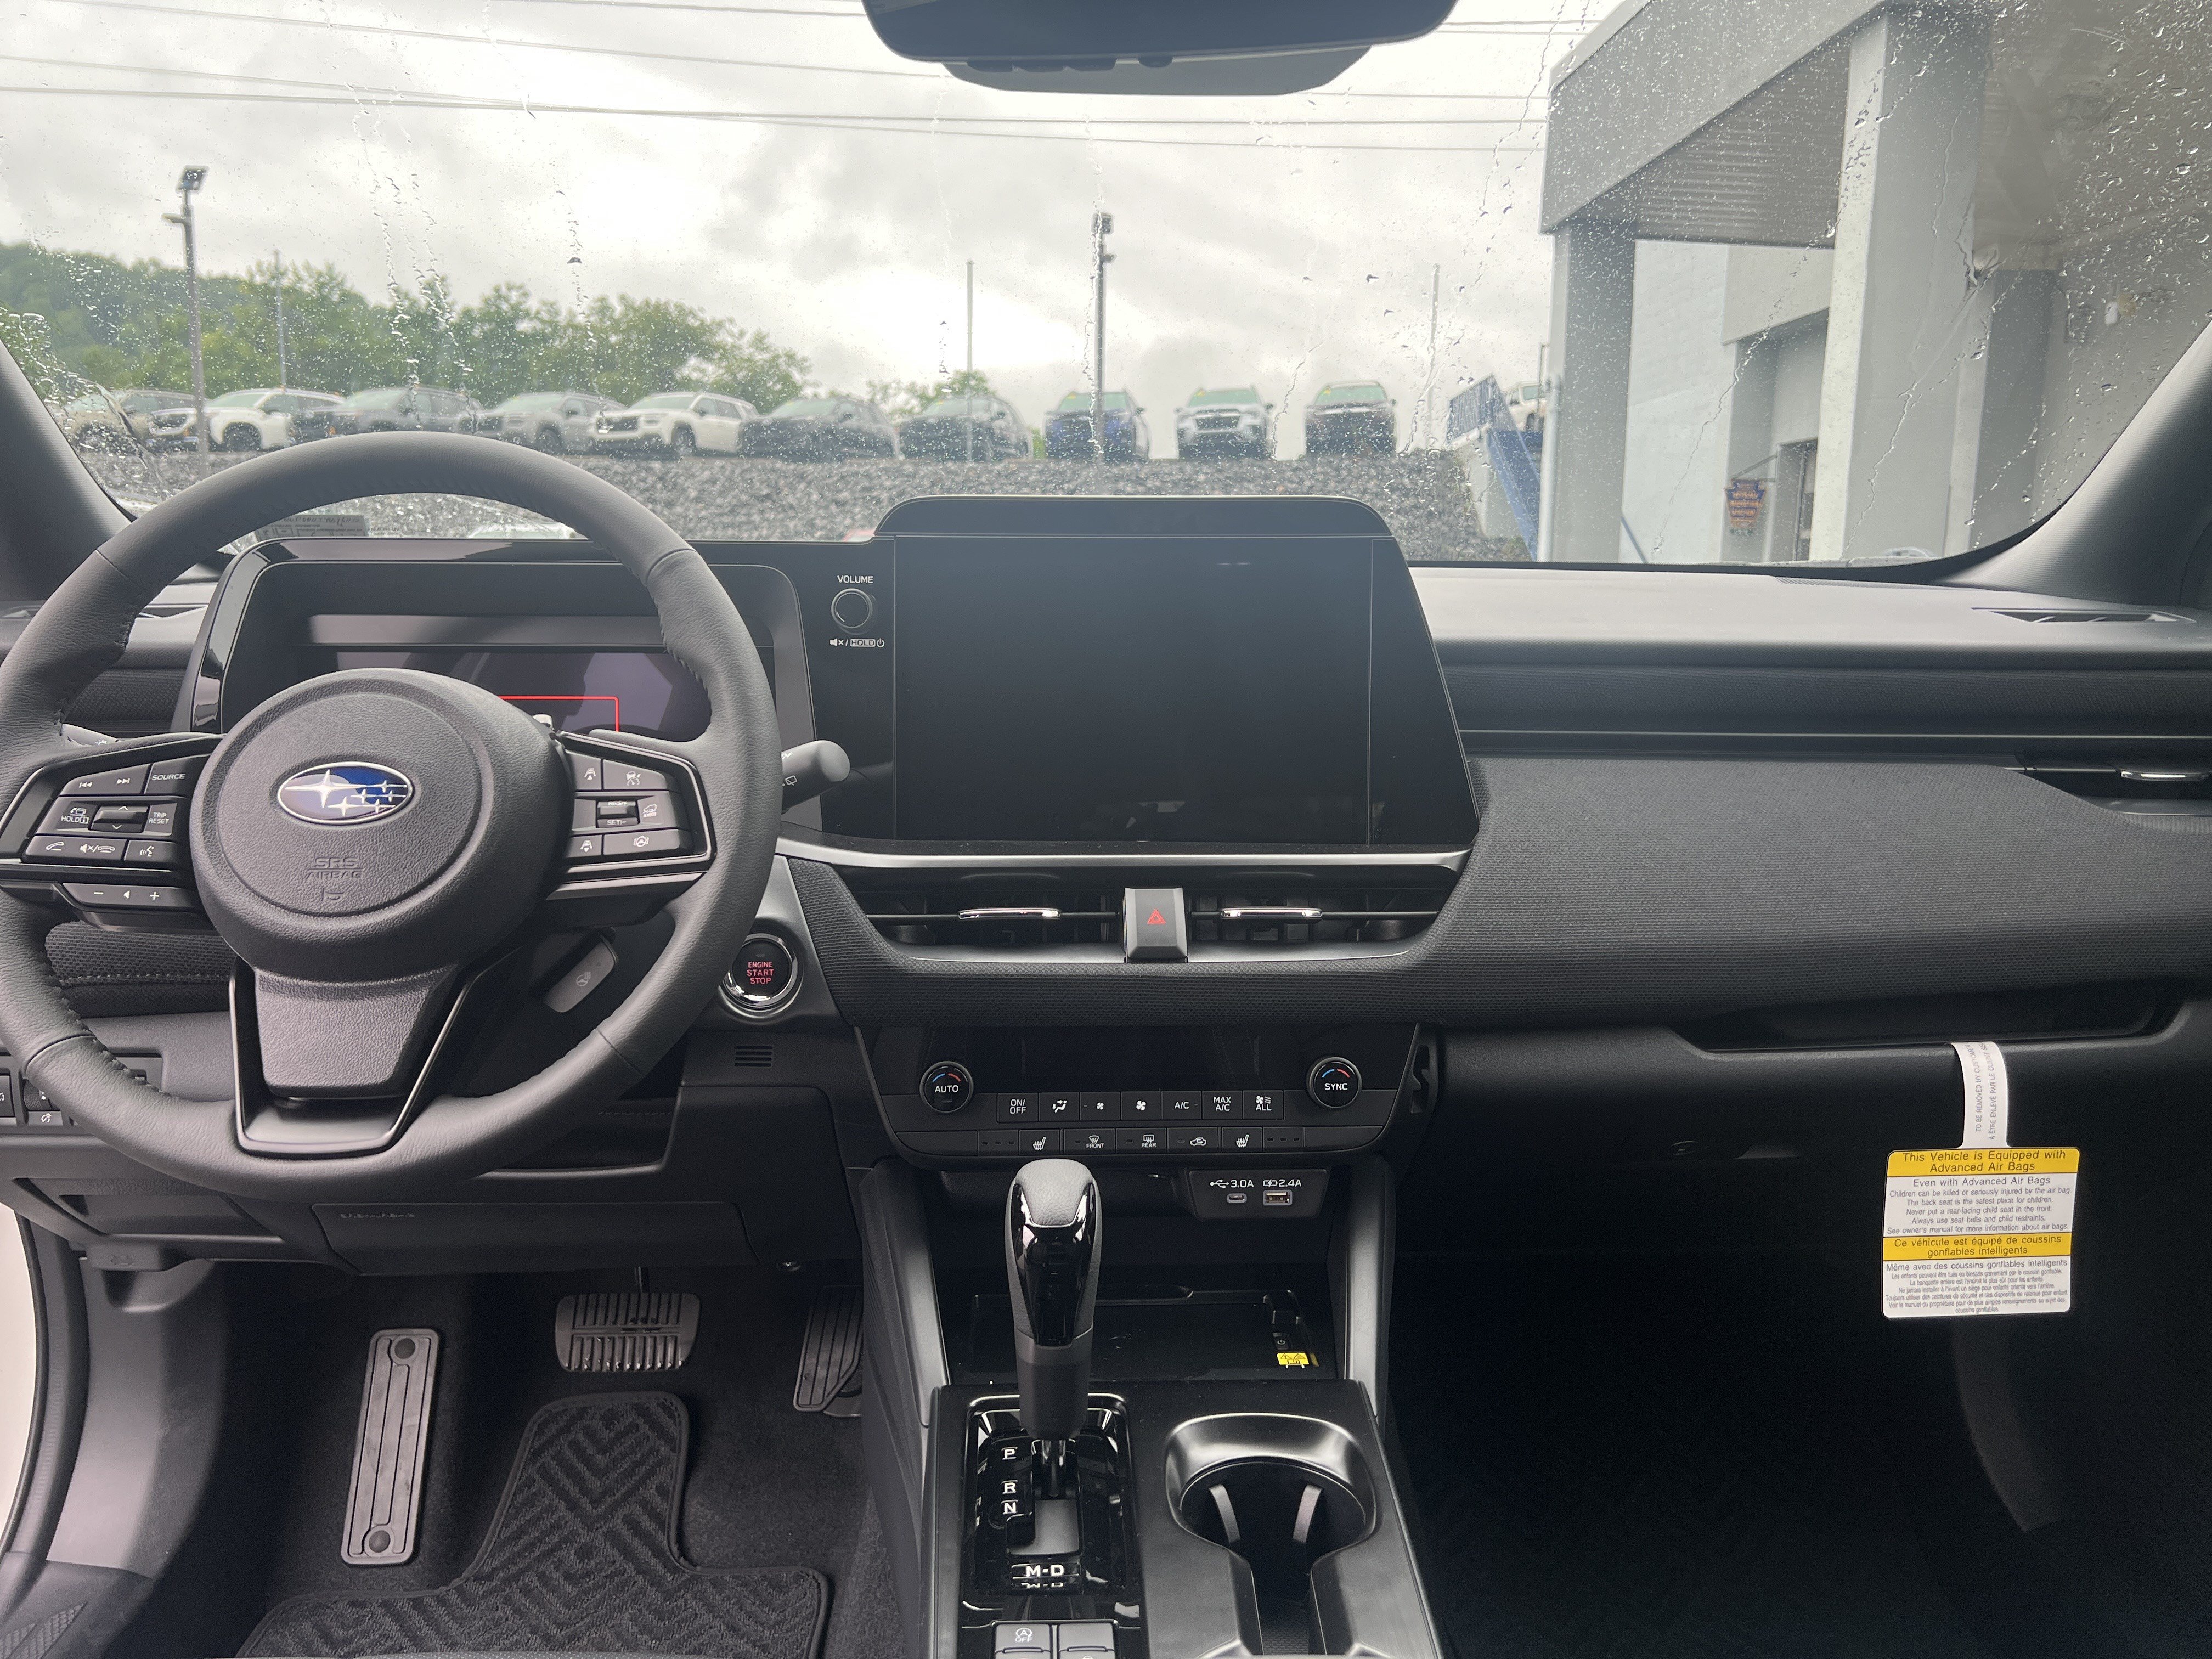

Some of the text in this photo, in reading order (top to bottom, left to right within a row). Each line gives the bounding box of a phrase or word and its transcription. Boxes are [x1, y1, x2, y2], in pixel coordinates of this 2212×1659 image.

[313, 857, 359, 868] SRS
[306, 871, 363, 879] AIRBAG
[1983, 1052, 1994, 1071] CLIENT
[1976, 1115, 1982, 1123] BE
[1904, 1150, 2066, 1161] This Vehicle is Equipped with
[1930, 1161, 2035, 1172] Advanced Air Bags
[1230, 1180, 1254, 1188] 3.0A
[1278, 1179, 1302, 1187] 2.4A
[1913, 1178, 1936, 1187] Even
[1962, 1177, 2007, 1186] Advanced
[2010, 1177, 2023, 1185] Air
[2027, 1176, 2050, 1186] Bags
[1971, 1188, 1999, 1196] seriously
[2001, 1187, 2022, 1195] injured
[1946, 1207, 1980, 1215] rear-facing
[1911, 1217, 1934, 1226] Always
[1911, 1238, 1949, 1246] véhicule
[1971, 1237, 2002, 1246] équipé
[2006, 1236, 2017, 1244] de
[2021, 1235, 2061, 1244] coussins
[1928, 1246, 2028, 1257] gonflables intelligents
[1987, 1260, 2025, 1269] gonflables
[2028, 1259, 2067, 1268] intelligents
[1004, 1449, 1015, 1458] P
[1004, 1482, 1016, 1492] R
[1004, 1502, 1016, 1513] N
